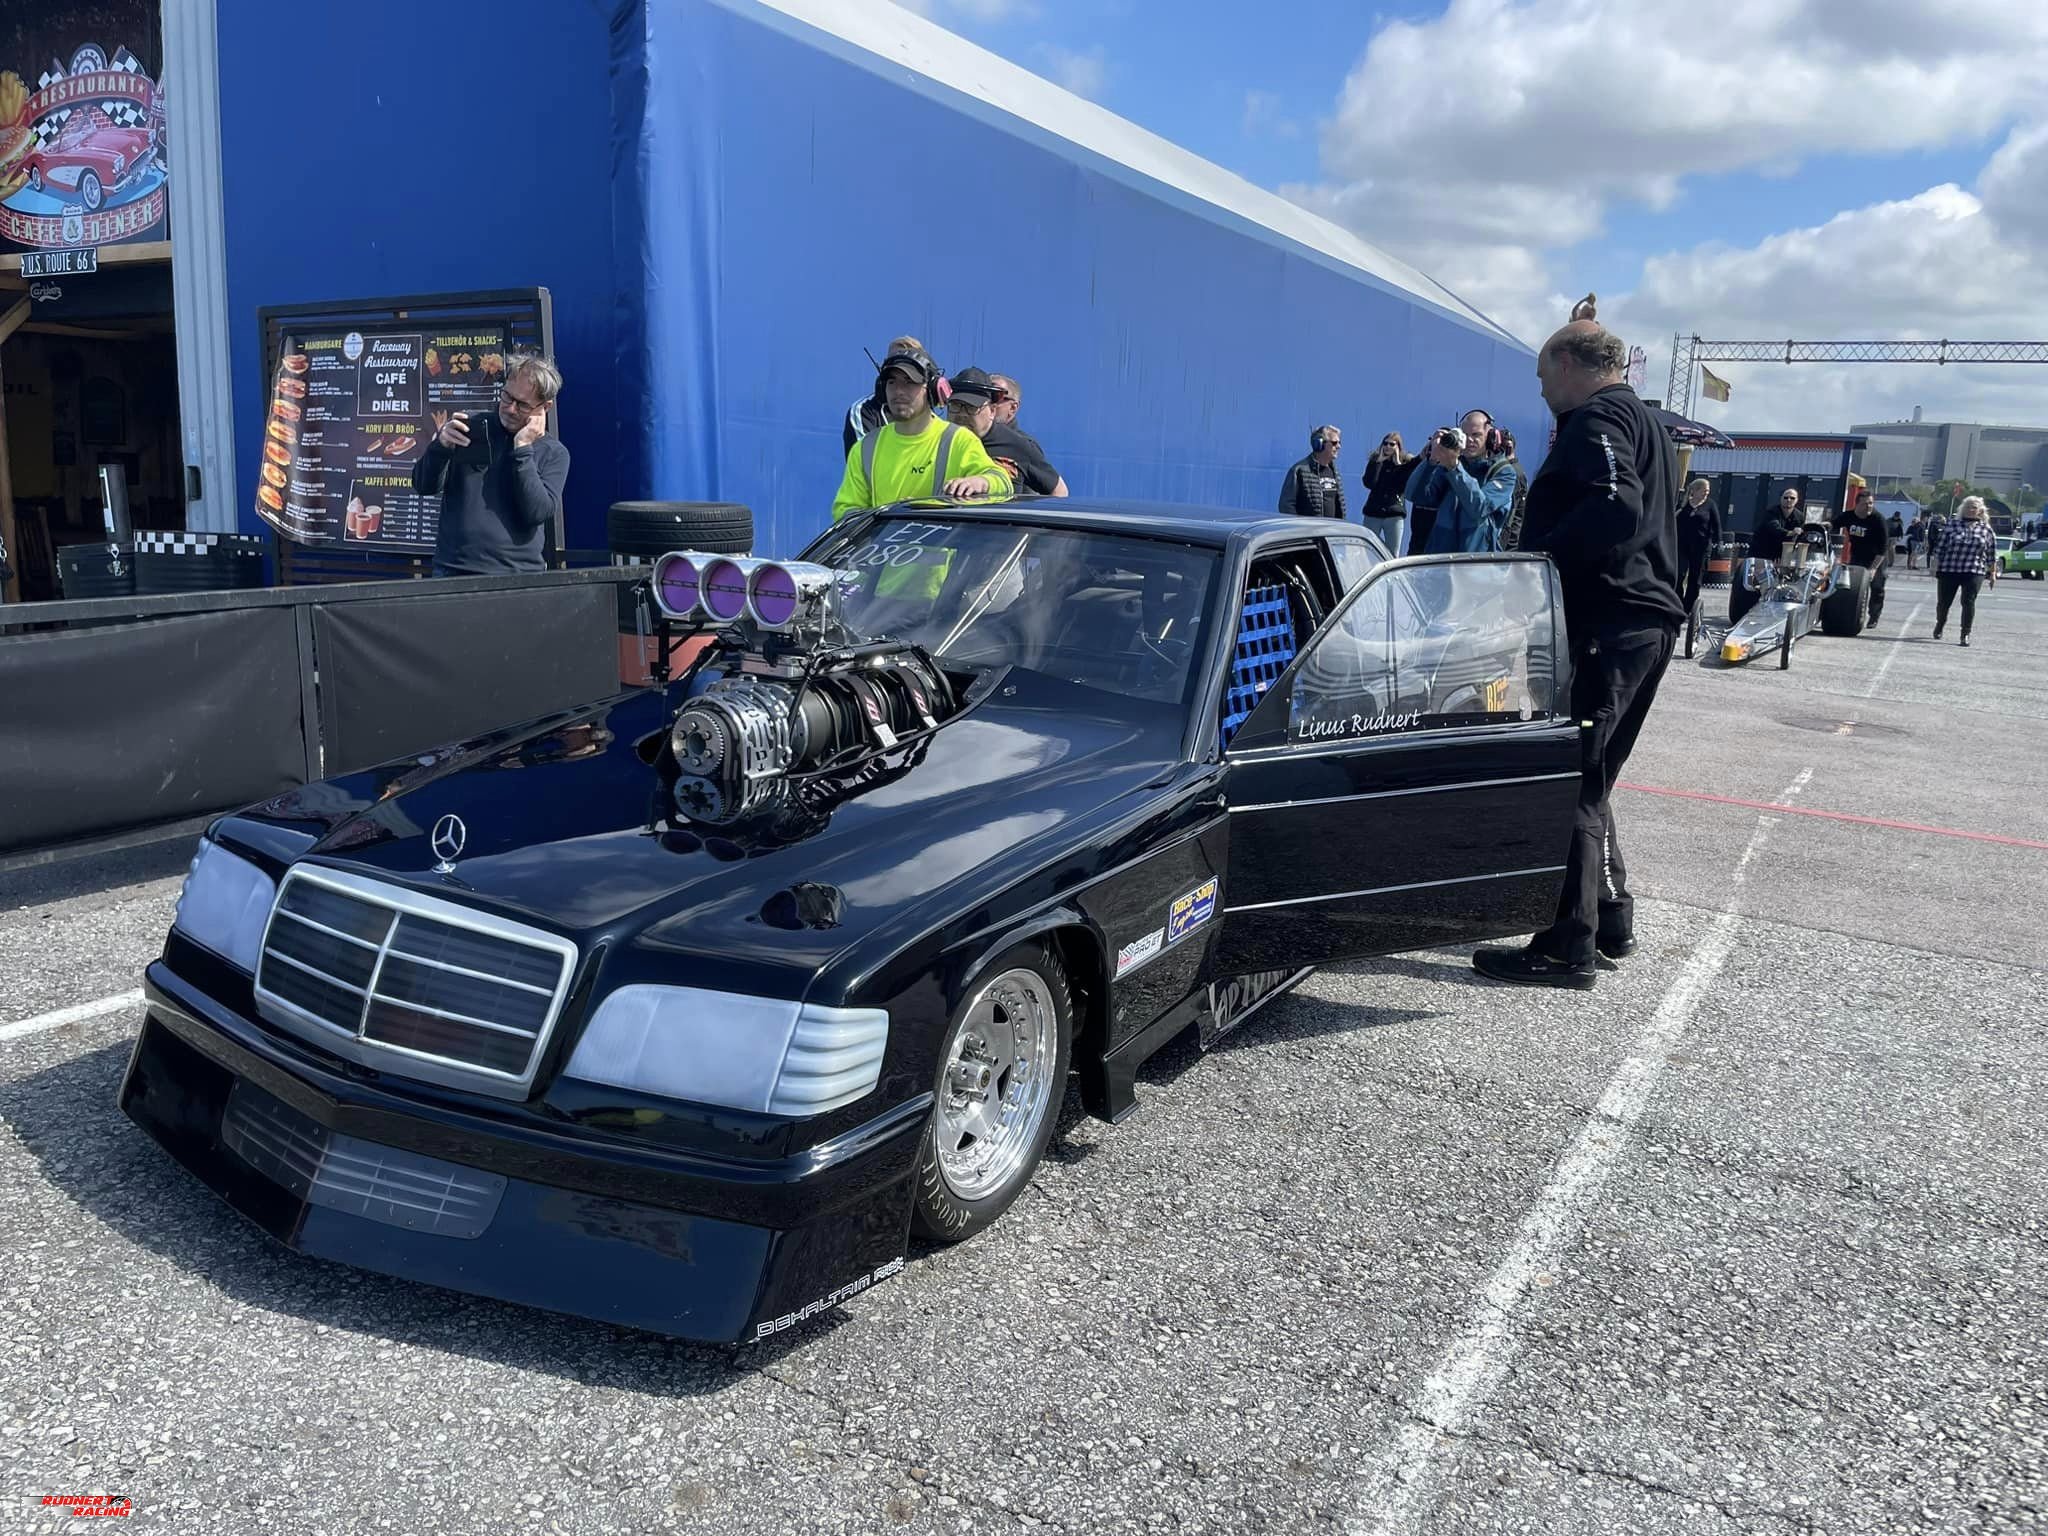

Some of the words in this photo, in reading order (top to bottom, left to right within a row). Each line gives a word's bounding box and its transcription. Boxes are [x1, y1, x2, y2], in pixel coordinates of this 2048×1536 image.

[41, 75, 137, 107] RESTAURANT
[91, 202, 152, 241] DINER
[28, 255, 43, 273] U.S.
[45, 252, 71, 272] ROUTE
[77, 251, 88, 270] 66
[373, 340, 411, 355] Raceway
[364, 356, 418, 370] Restaurang
[376, 368, 407, 385] CAFÉ
[386, 386, 394, 397] &
[372, 400, 409, 412] DINER
[1298, 715, 1346, 738] Linus
[1351, 708, 1421, 733] Rudnert
